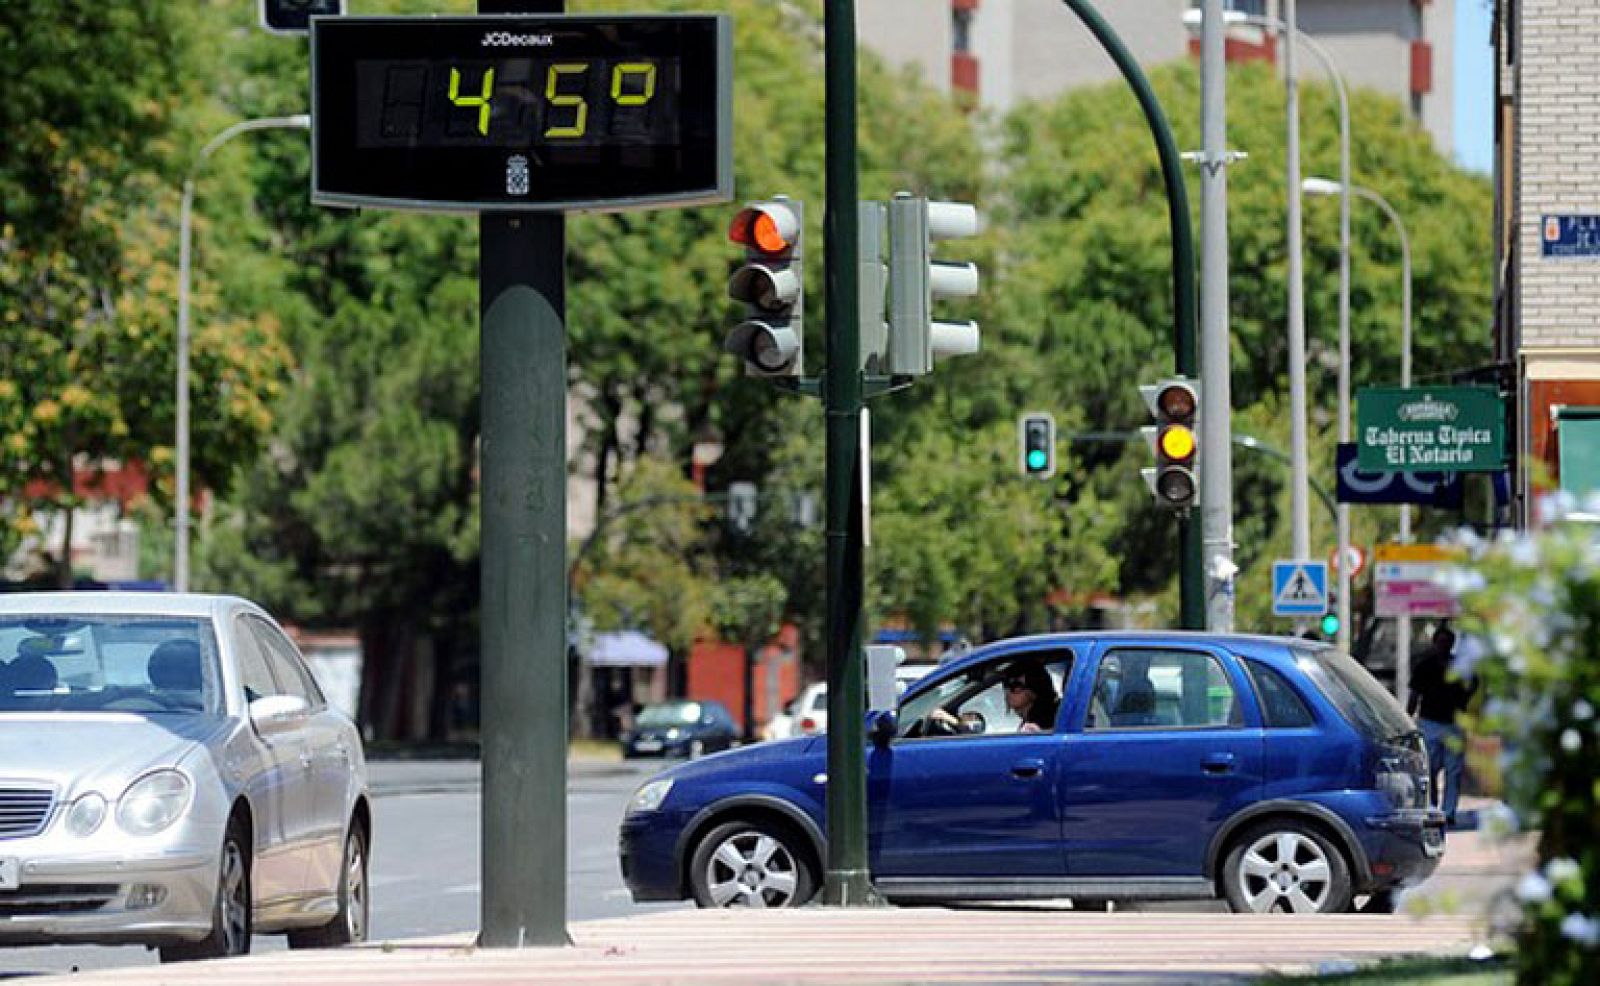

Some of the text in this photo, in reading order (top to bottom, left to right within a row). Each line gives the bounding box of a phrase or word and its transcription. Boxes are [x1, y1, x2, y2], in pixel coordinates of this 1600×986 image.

[481, 31, 552, 47] JCDecaux
[1366, 427, 1434, 445] Taberna
[1386, 446, 1473, 464] El Notario
